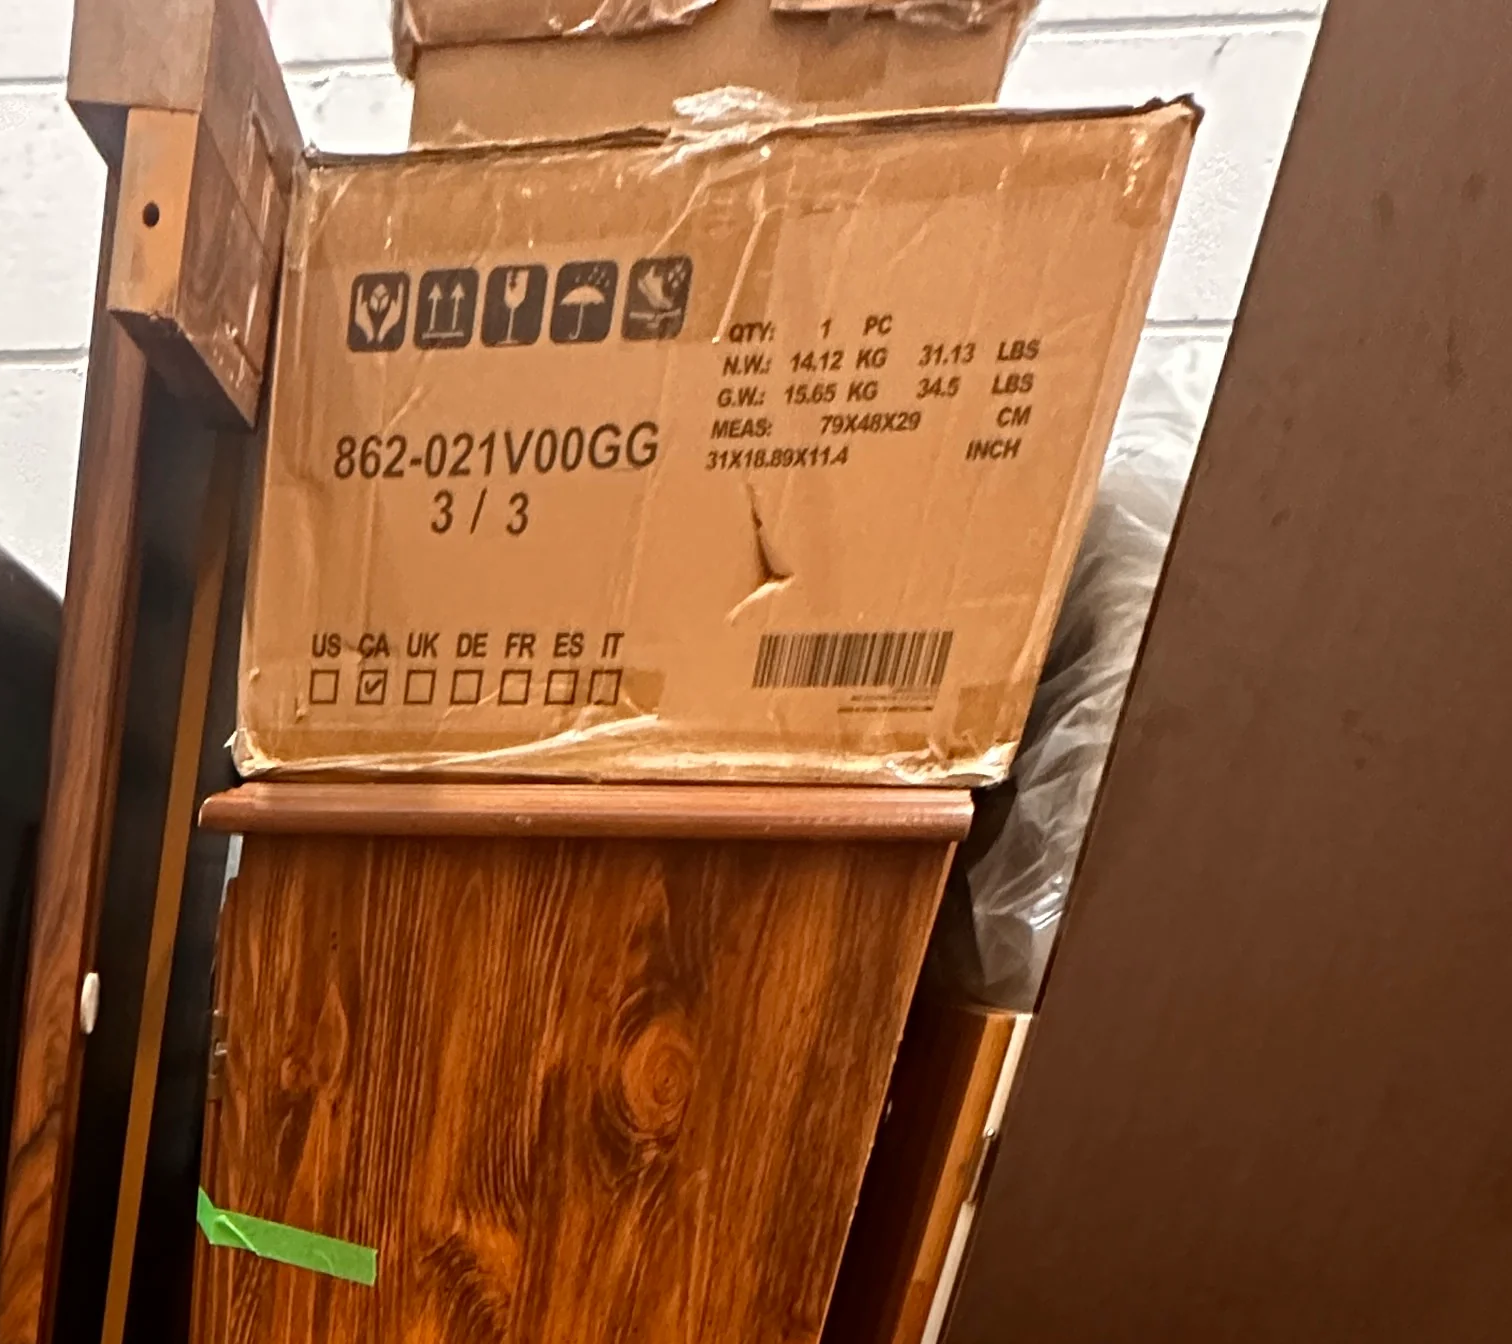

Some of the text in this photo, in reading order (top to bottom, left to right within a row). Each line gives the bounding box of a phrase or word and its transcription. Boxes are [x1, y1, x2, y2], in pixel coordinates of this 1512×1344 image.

[729, 315, 893, 343] QTY: 1 PC
[722, 339, 1040, 377] N.W.: 14.12 KG 31.13 LBS
[717, 373, 1034, 408] G.W.: 15.65 KG 34.5 LBS
[710, 405, 1033, 440] MEAS: 79X48X29 CM
[333, 421, 660, 480] 862-021V00GG
[965, 438, 1022, 463] INCH
[431, 487, 530, 535] 3 / 3
[312, 632, 625, 659] US CA UK DE FR ES IT
